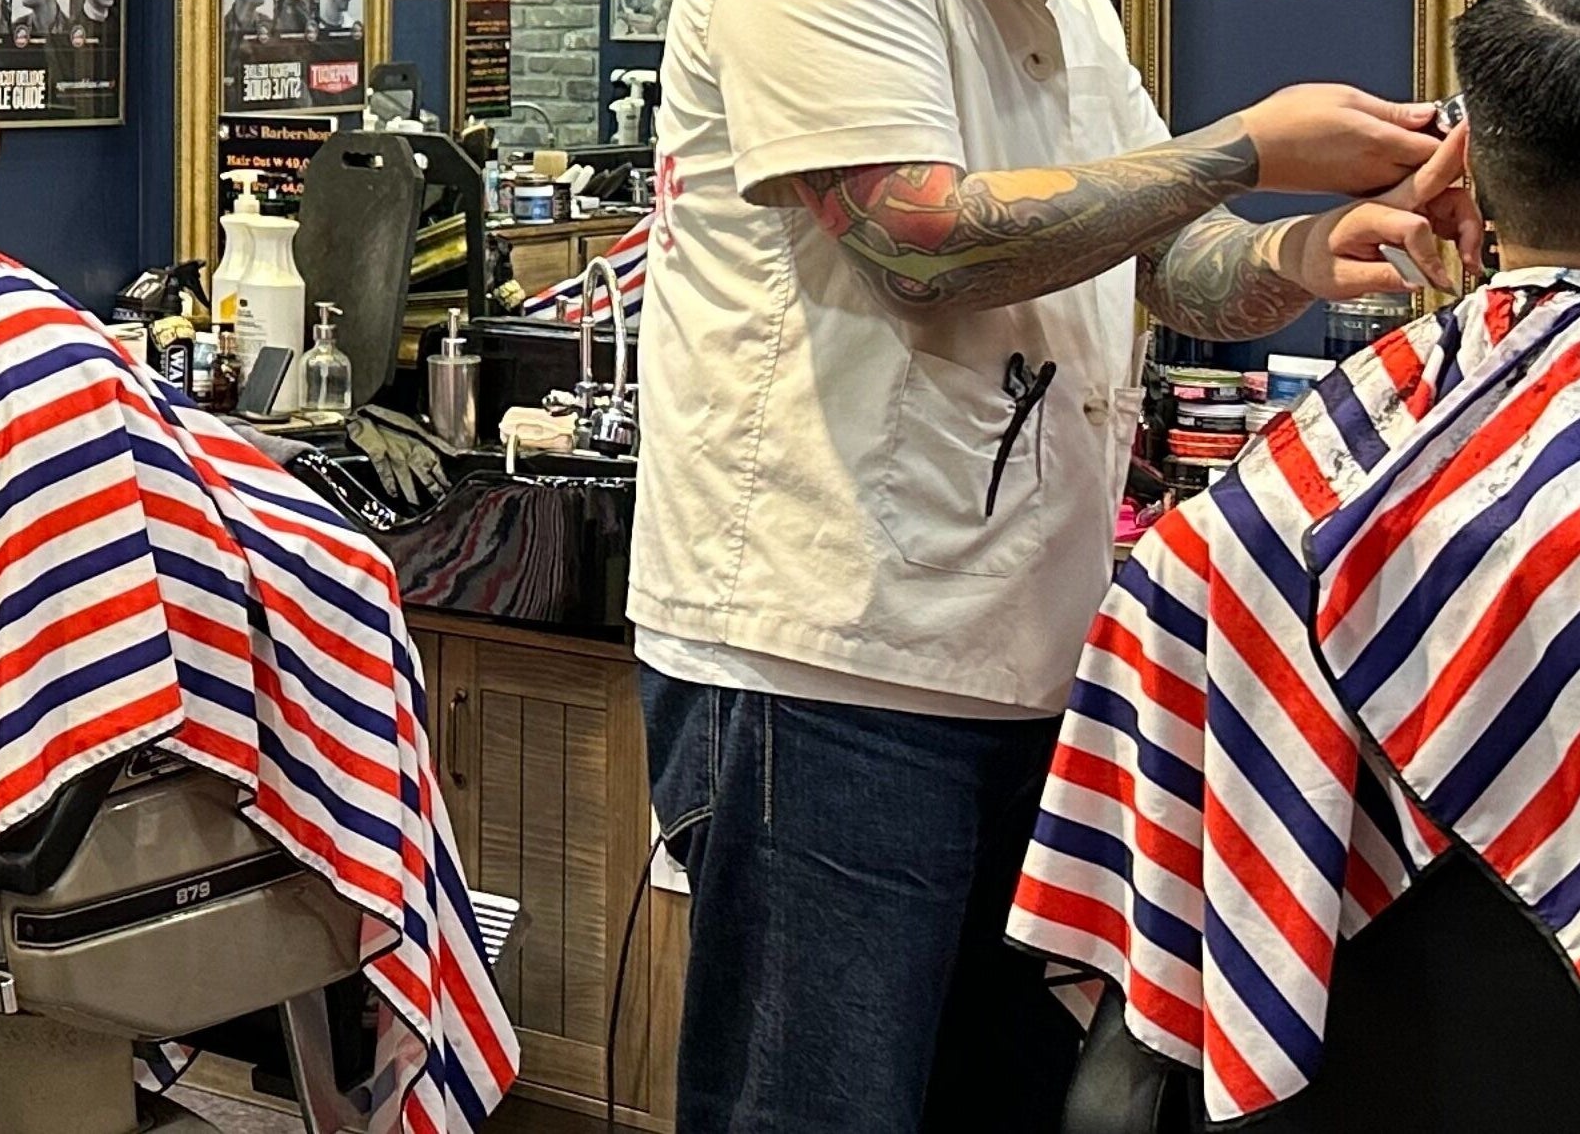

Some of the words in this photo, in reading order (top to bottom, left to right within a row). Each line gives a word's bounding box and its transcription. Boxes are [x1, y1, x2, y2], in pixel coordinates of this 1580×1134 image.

[12, 86, 46, 109] GUIDE
[226, 154, 251, 167] Hair
[176, 881, 211, 905] 879
